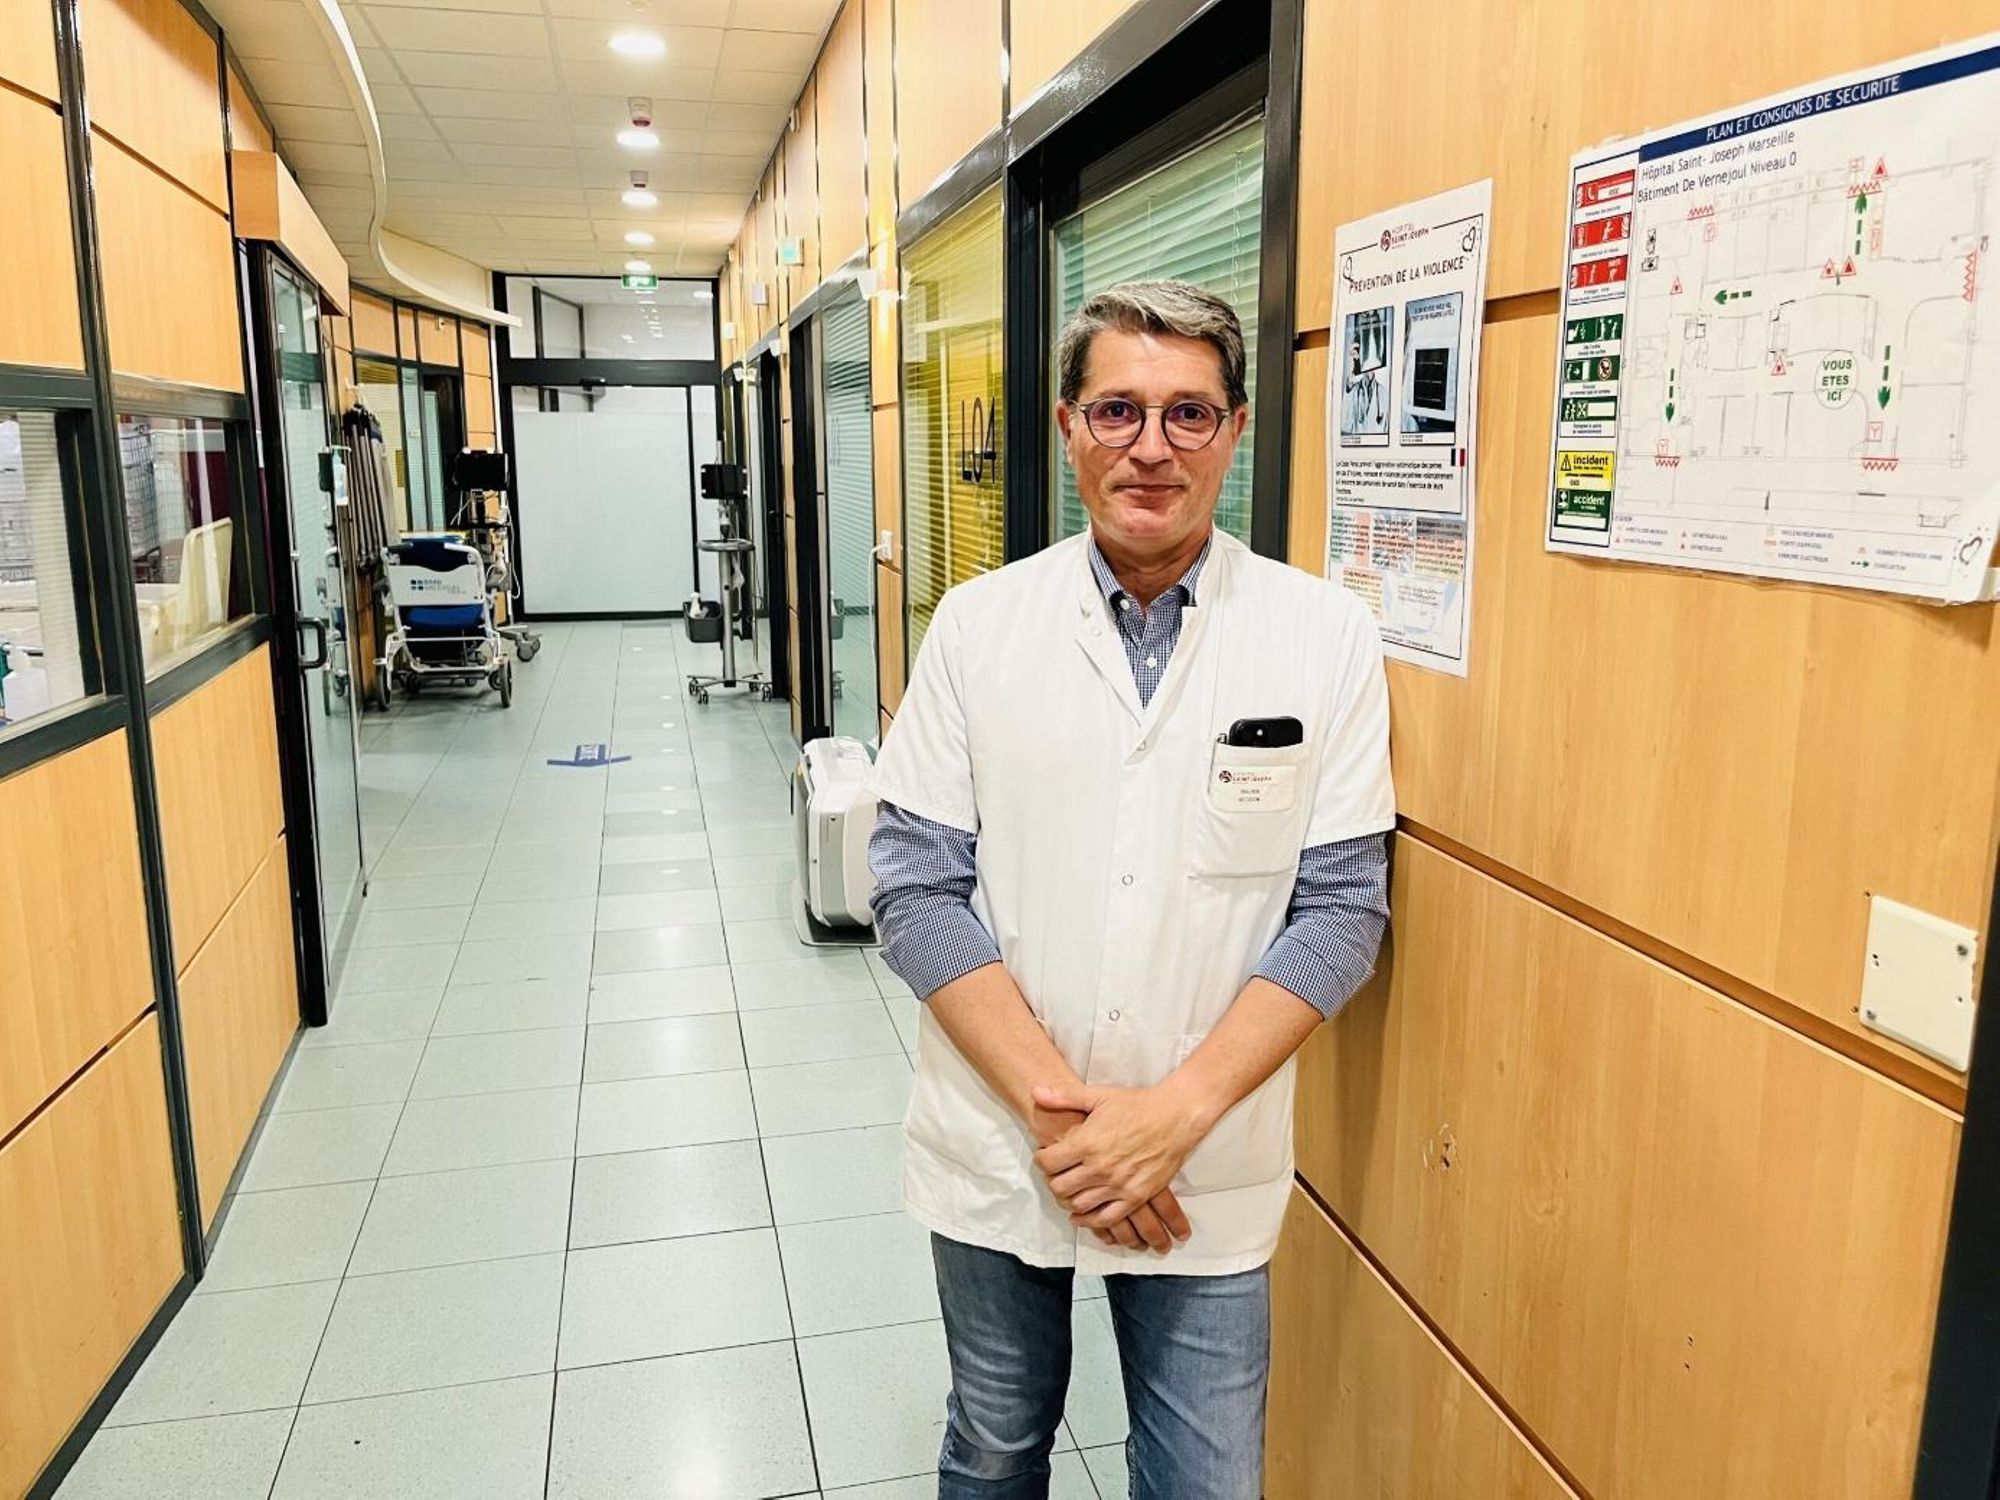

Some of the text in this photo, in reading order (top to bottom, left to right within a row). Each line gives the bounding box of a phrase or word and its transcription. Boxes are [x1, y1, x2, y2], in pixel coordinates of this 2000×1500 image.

[1706, 76, 1900, 142] PLAN ET CONSIGNES DE SECURITE
[1642, 161, 1675, 181] Hôpital
[1709, 144, 1744, 165] Joseph
[1749, 131, 1796, 152] Marseille
[1637, 183, 1679, 204] Bâtiment
[1682, 178, 1695, 192] De
[1698, 165, 1747, 189] Vernejoul
[1750, 156, 1787, 175] Niveau
[1395, 269, 1406, 283] DE
[1410, 267, 1420, 280] LA
[1423, 256, 1464, 277] VIOLENCE
[1823, 359, 1852, 370] VOUS
[1822, 375, 1849, 386] ETES
[1827, 391, 1842, 401] ICI
[1573, 454, 1609, 466] incident
[1573, 494, 1605, 506] accident
